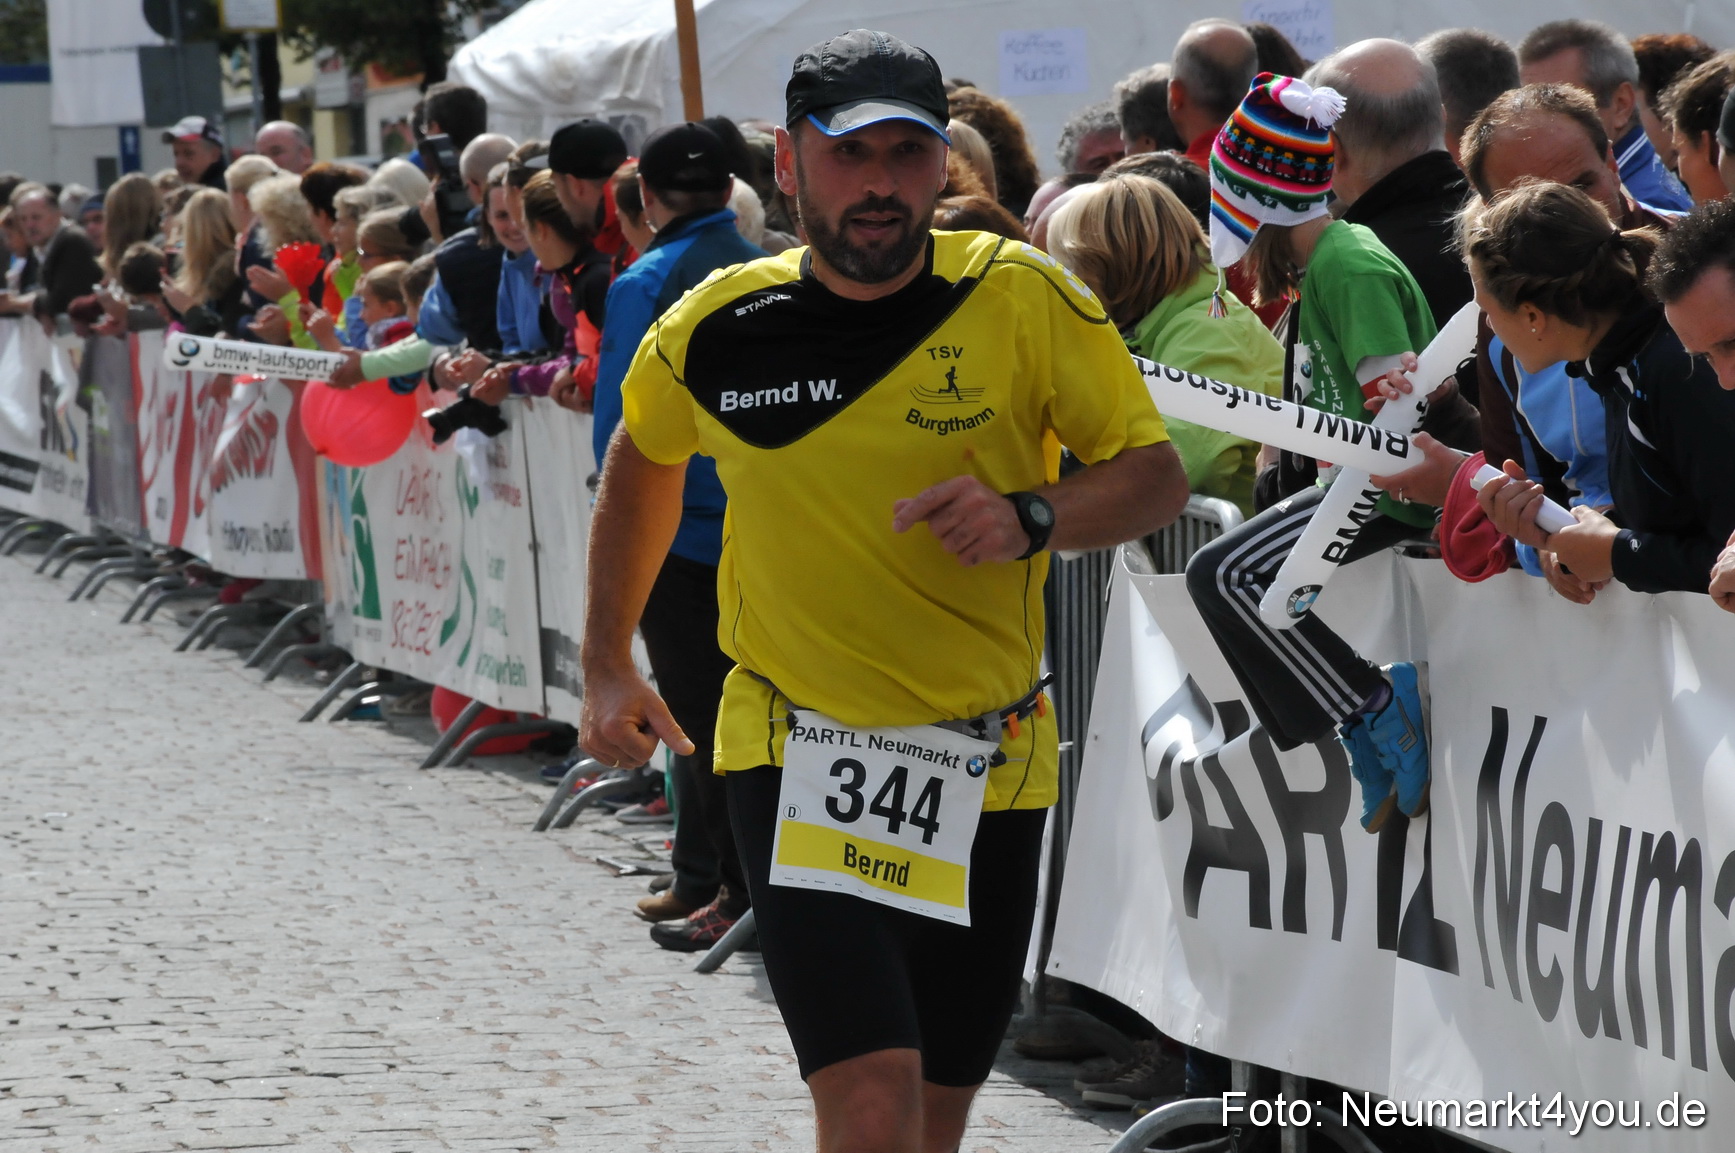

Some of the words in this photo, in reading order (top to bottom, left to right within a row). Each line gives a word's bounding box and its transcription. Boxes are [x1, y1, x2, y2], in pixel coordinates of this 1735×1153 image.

[926, 346, 963, 361] TSV
[719, 381, 798, 412] Bernd
[808, 378, 842, 401] W.
[905, 407, 995, 436] Burgthann
[1313, 410, 1409, 459] BMW
[1287, 585, 1311, 614] BMW
[792, 725, 862, 748] PARTL
[868, 734, 960, 770] Neumarkt
[787, 806, 796, 818] D
[825, 757, 945, 846] 344
[843, 842, 911, 888] Bernd
